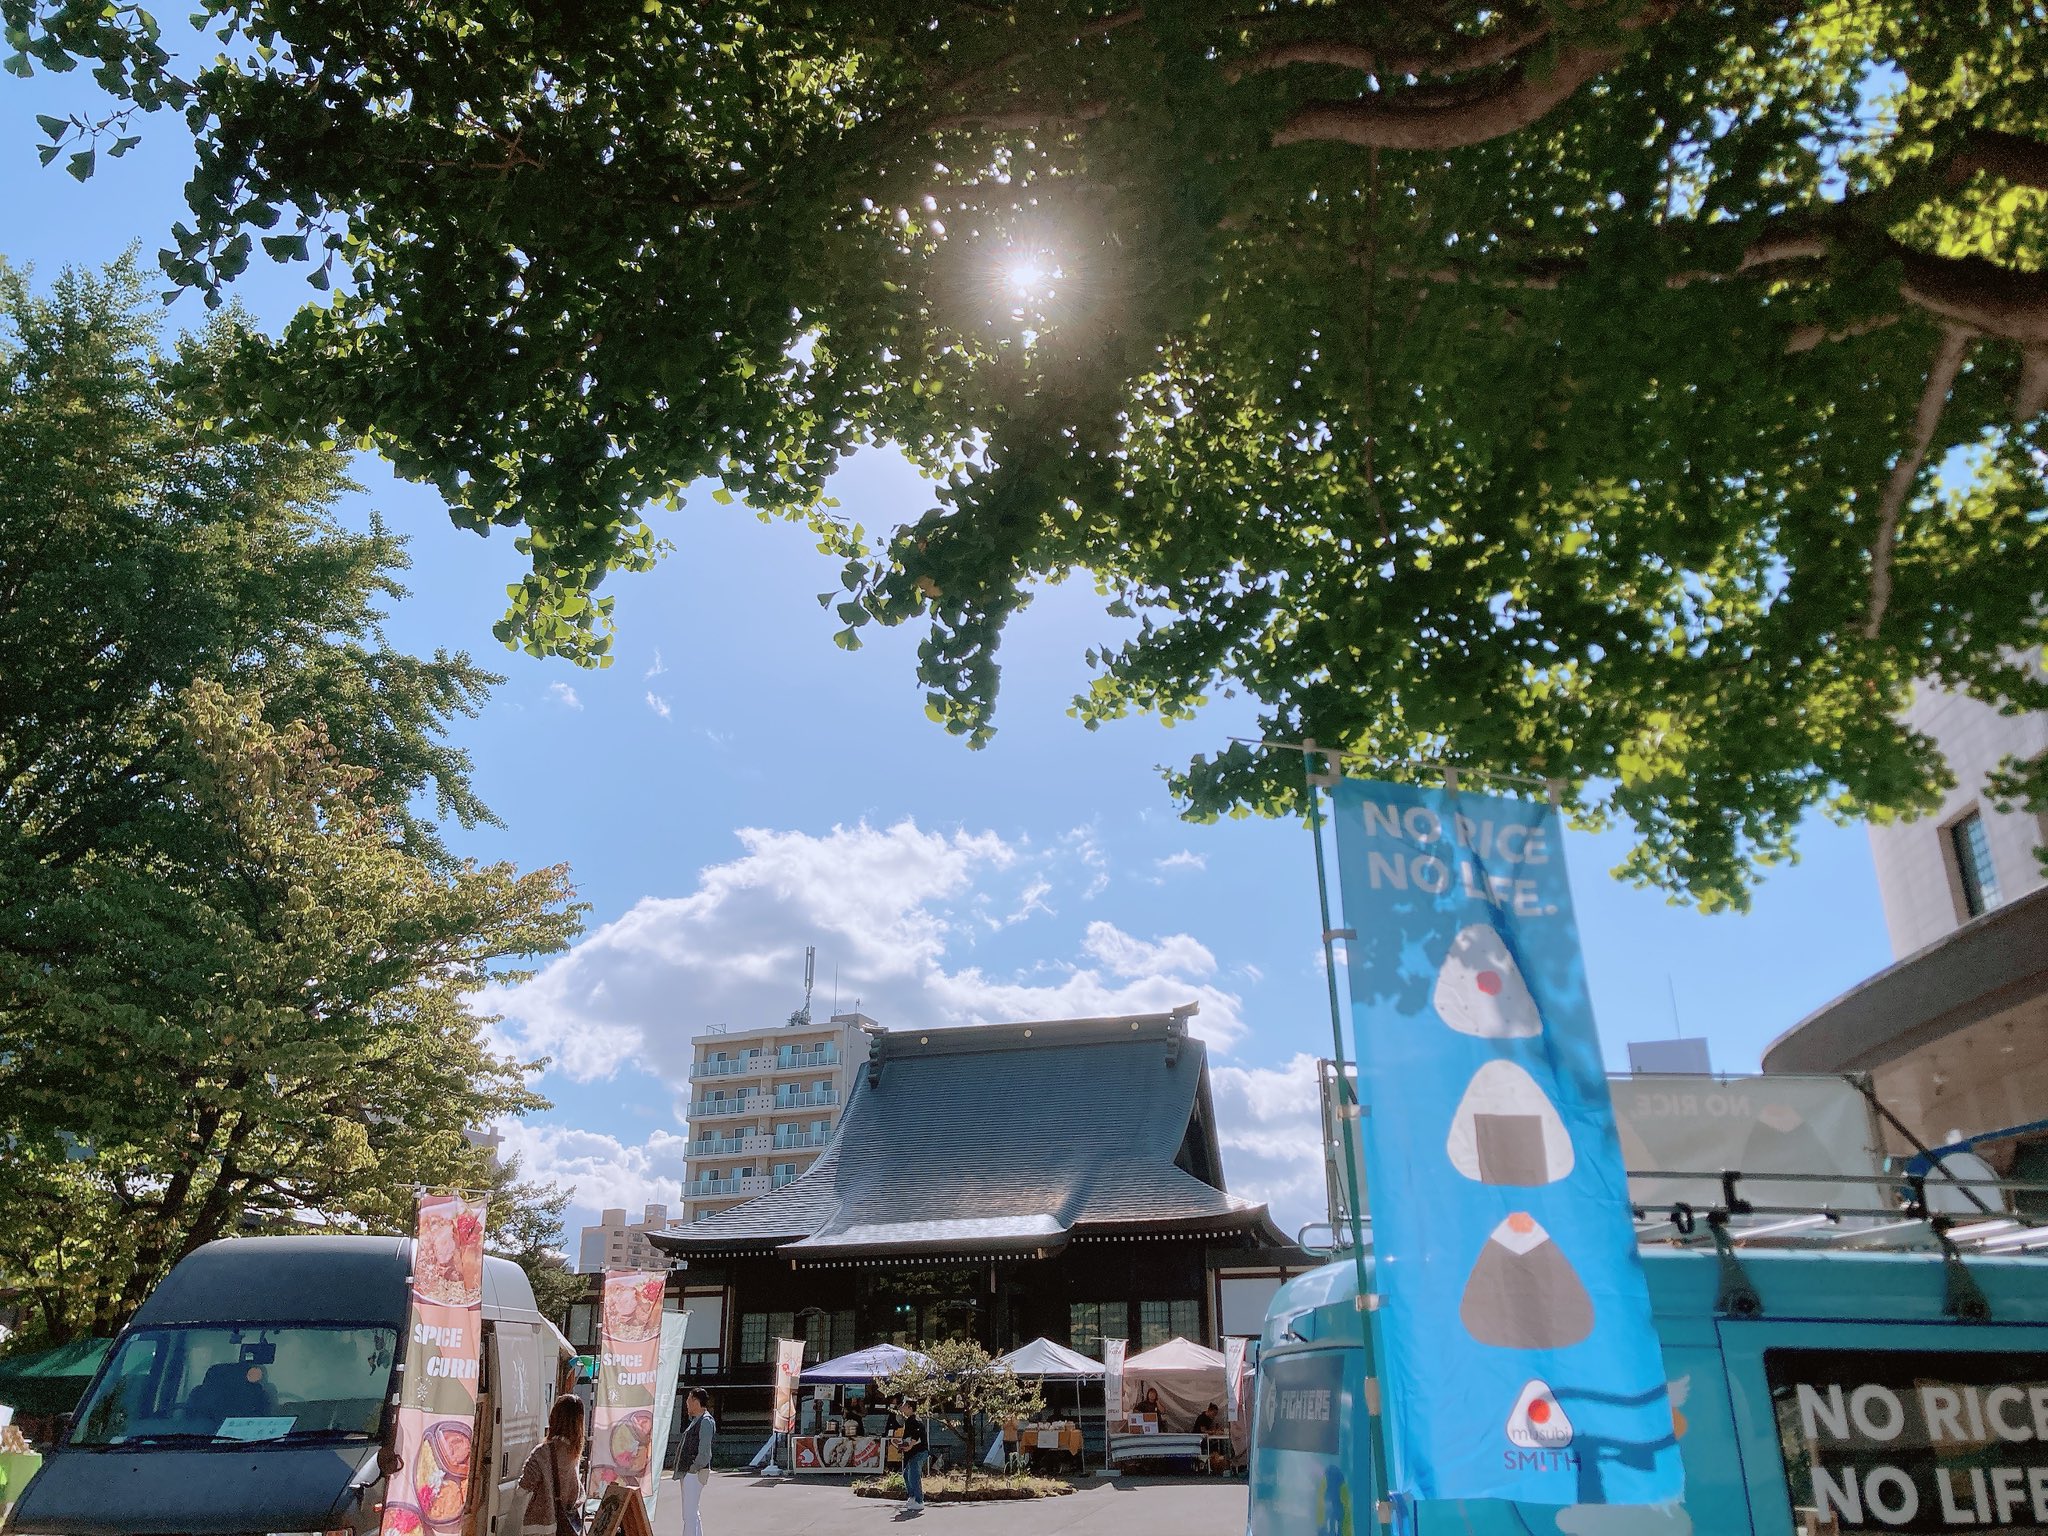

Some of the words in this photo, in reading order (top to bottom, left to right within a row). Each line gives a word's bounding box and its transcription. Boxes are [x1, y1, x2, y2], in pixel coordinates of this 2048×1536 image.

[1362, 801, 1442, 844] NO
[1454, 811, 1549, 865] RICE
[1367, 851, 1450, 895] NO
[413, 1323, 463, 1348] SPICE
[426, 1356, 479, 1379] CURR
[602, 1352, 643, 1367] SPICE
[617, 1370, 657, 1386] CURR
[1280, 1389, 1331, 1421] FIGHTERS
[1797, 1384, 1905, 1441] NO
[1921, 1386, 2048, 1442] RICE
[1512, 1426, 1570, 1441] musubi
[1810, 1466, 1919, 1525] NO
[1935, 1467, 2048, 1524] LIFE
